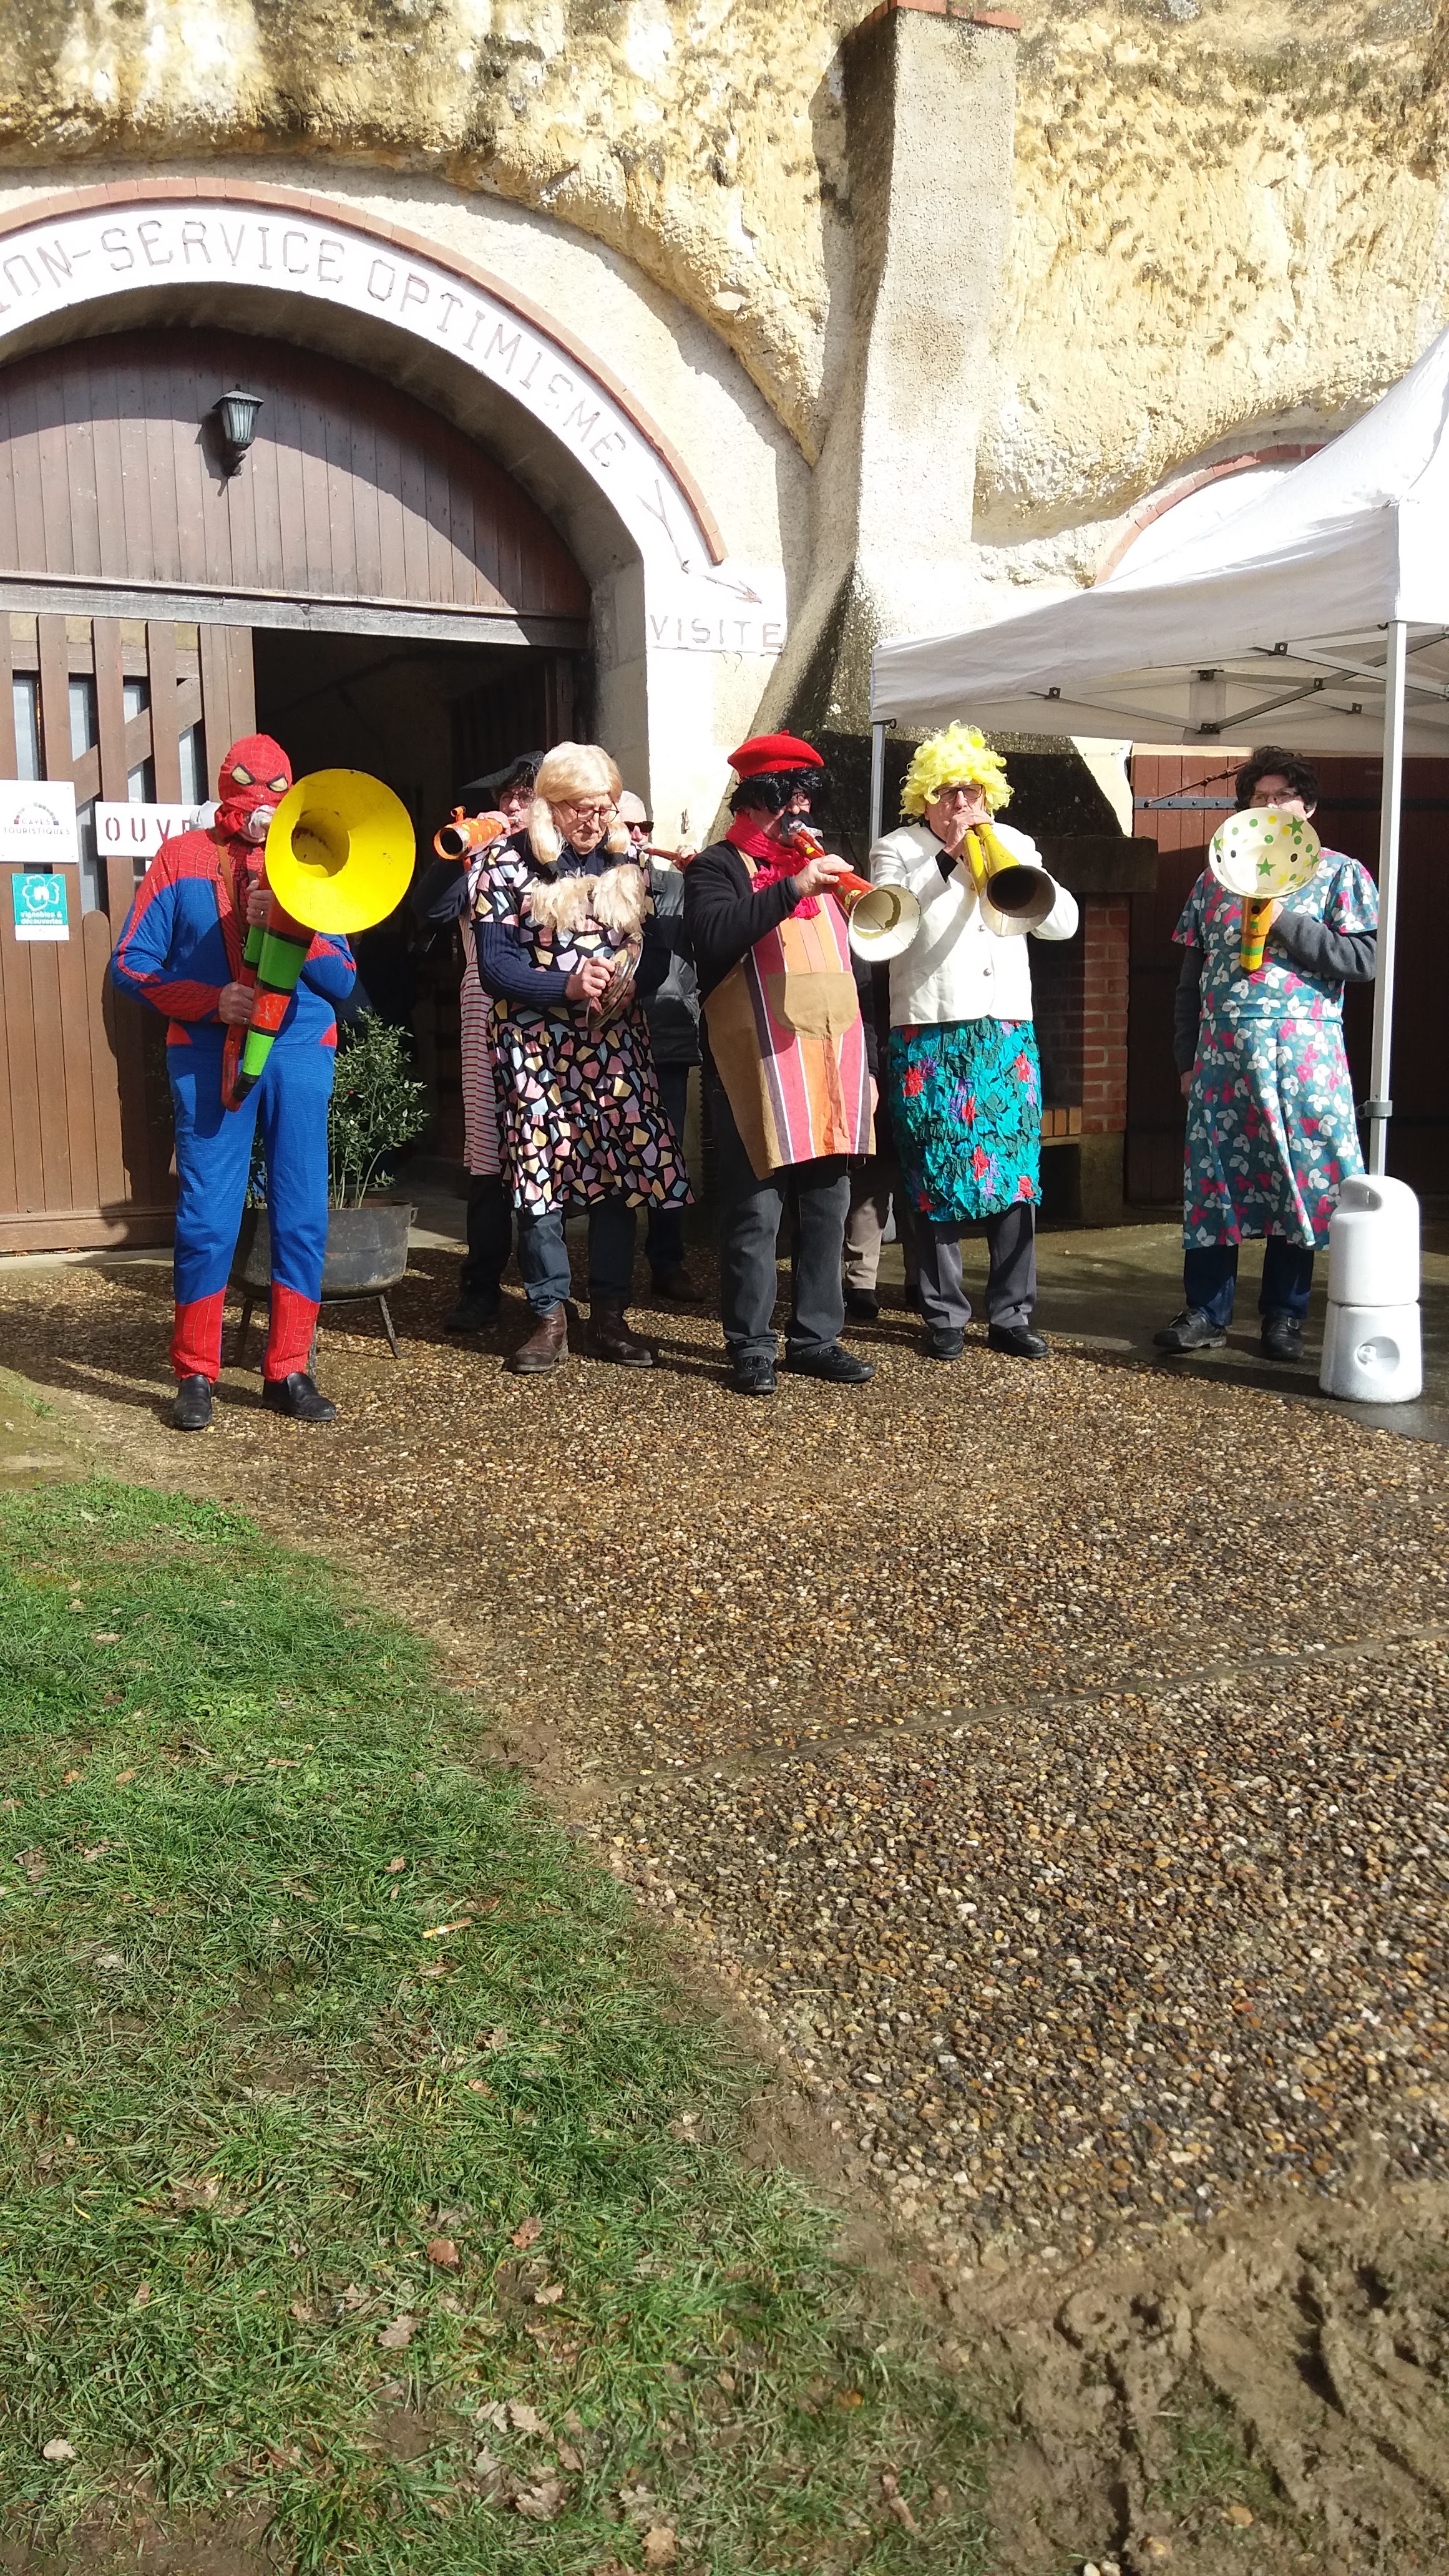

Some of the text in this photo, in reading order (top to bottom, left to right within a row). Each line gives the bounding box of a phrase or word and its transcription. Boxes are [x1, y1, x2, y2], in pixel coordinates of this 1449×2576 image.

[0, 220, 627, 467] ON-SERVICE OPTIMISME
[649, 613, 783, 648] VISITE
[4, 827, 70, 835] TOURISTIQUES
